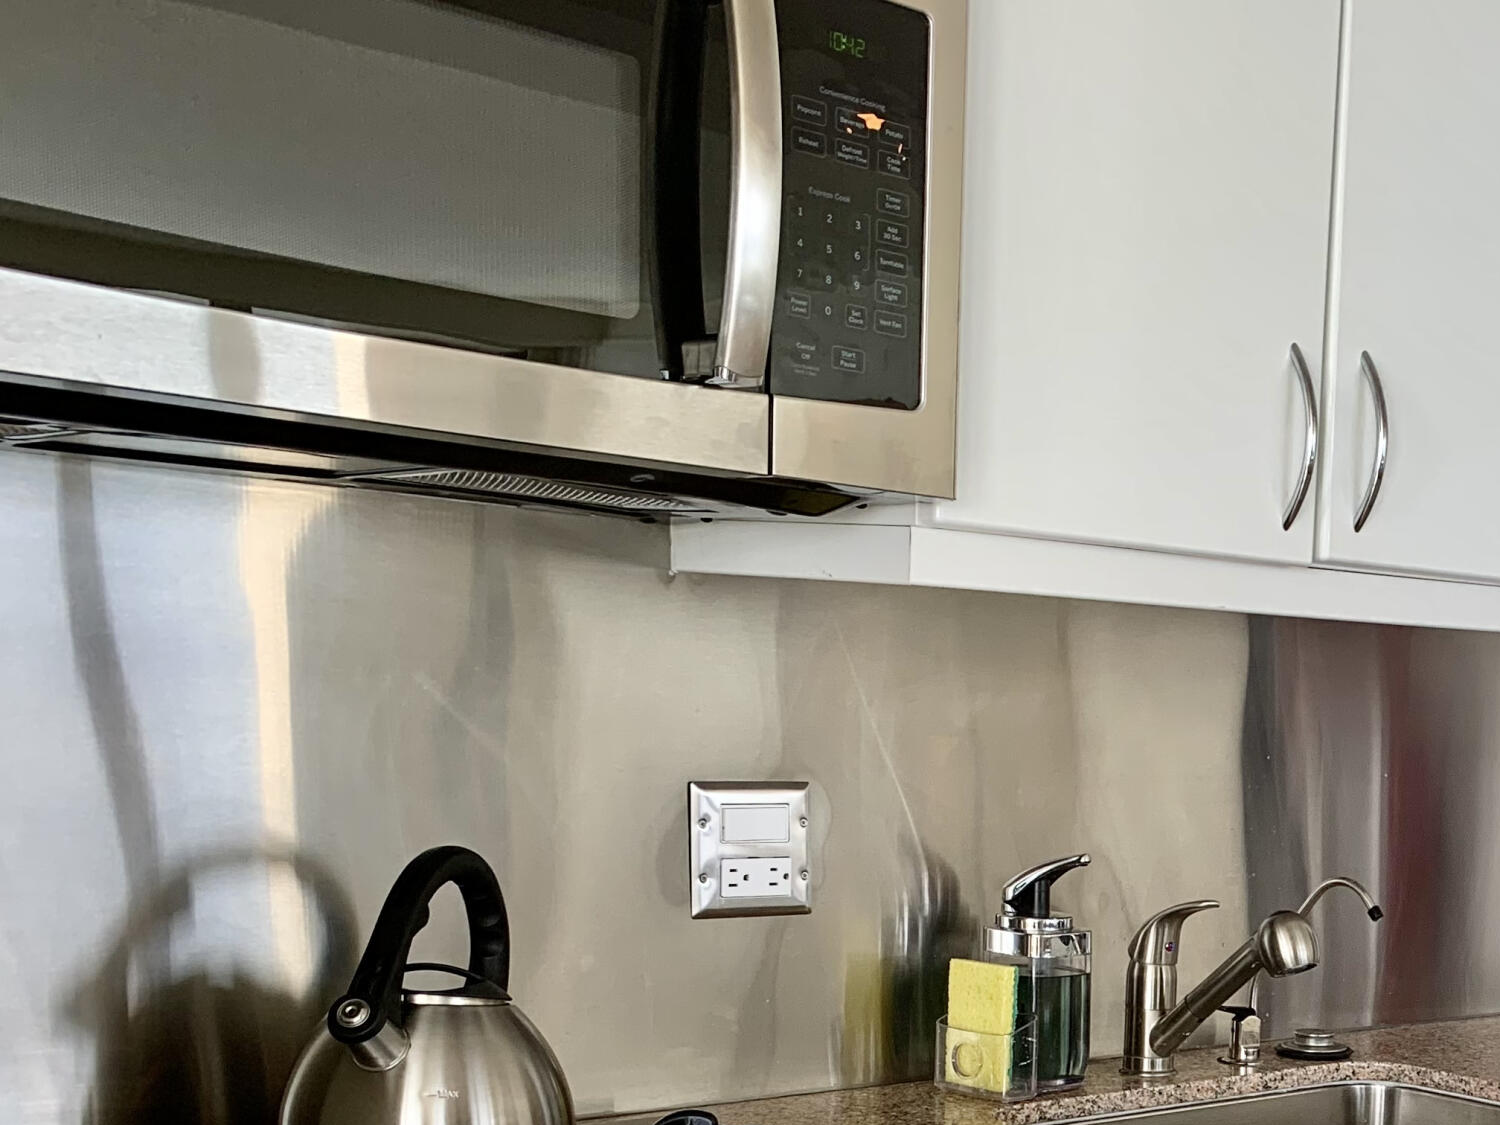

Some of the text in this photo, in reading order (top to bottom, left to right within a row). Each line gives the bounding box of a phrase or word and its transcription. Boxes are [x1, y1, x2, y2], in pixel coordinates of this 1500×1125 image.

[829, 31, 866, 58] 10:42
[797, 207, 862, 230] 1 2 3
[797, 238, 861, 261] 4 5 6
[797, 268, 860, 291] 7 8 9
[825, 306, 832, 316] 0
